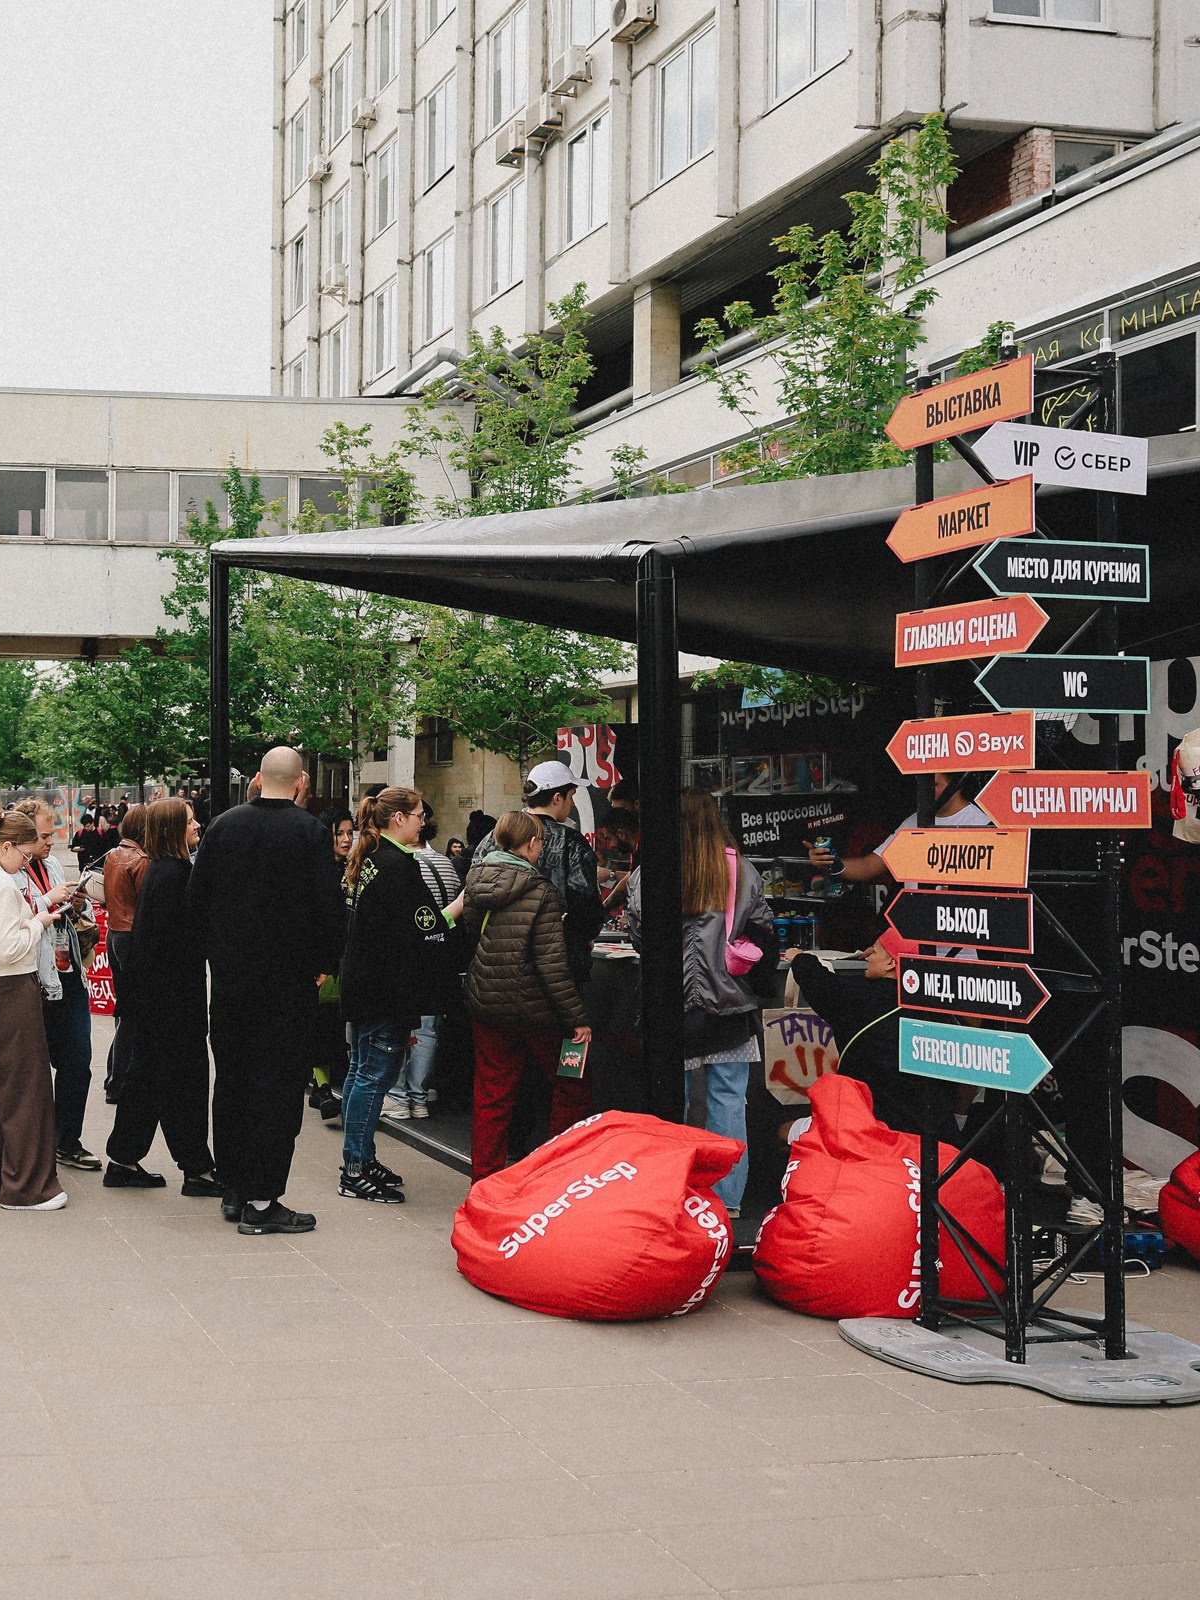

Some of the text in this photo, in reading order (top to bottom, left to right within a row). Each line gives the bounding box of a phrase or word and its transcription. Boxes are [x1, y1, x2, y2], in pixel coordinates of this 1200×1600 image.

[1034, 340, 1060, 365] АЯ
[926, 382, 1002, 429] ВЫСТАВКА
[1014, 440, 1131, 473] VIP СБЕР
[937, 502, 991, 539] МАРКЕТ
[1007, 556, 1141, 584] МЕСТО ДЛЯ КУРЕНИЯ
[903, 612, 1018, 652] ГЛАВНАЯ СЦЕНА
[1063, 671, 1088, 698] WC
[906, 733, 1025, 763] СЦЕНА Звук
[741, 802, 832, 828] Все кроссовки
[1011, 787, 1137, 818] СЦЕНА ПРИЧАЛ
[742, 826, 780, 846] здесь!
[822, 813, 844, 827] только
[926, 843, 994, 874] ФУДКОРТ
[936, 905, 990, 940] ВЫХОД
[1121, 930, 1200, 973] rSte
[923, 972, 1022, 1010] МЕД. ПОМОЩЬ
[911, 1035, 1011, 1076] STEREOLOUNGE
[498, 1161, 638, 1259] SuperStep
[671, 1195, 729, 1317] uperStep
